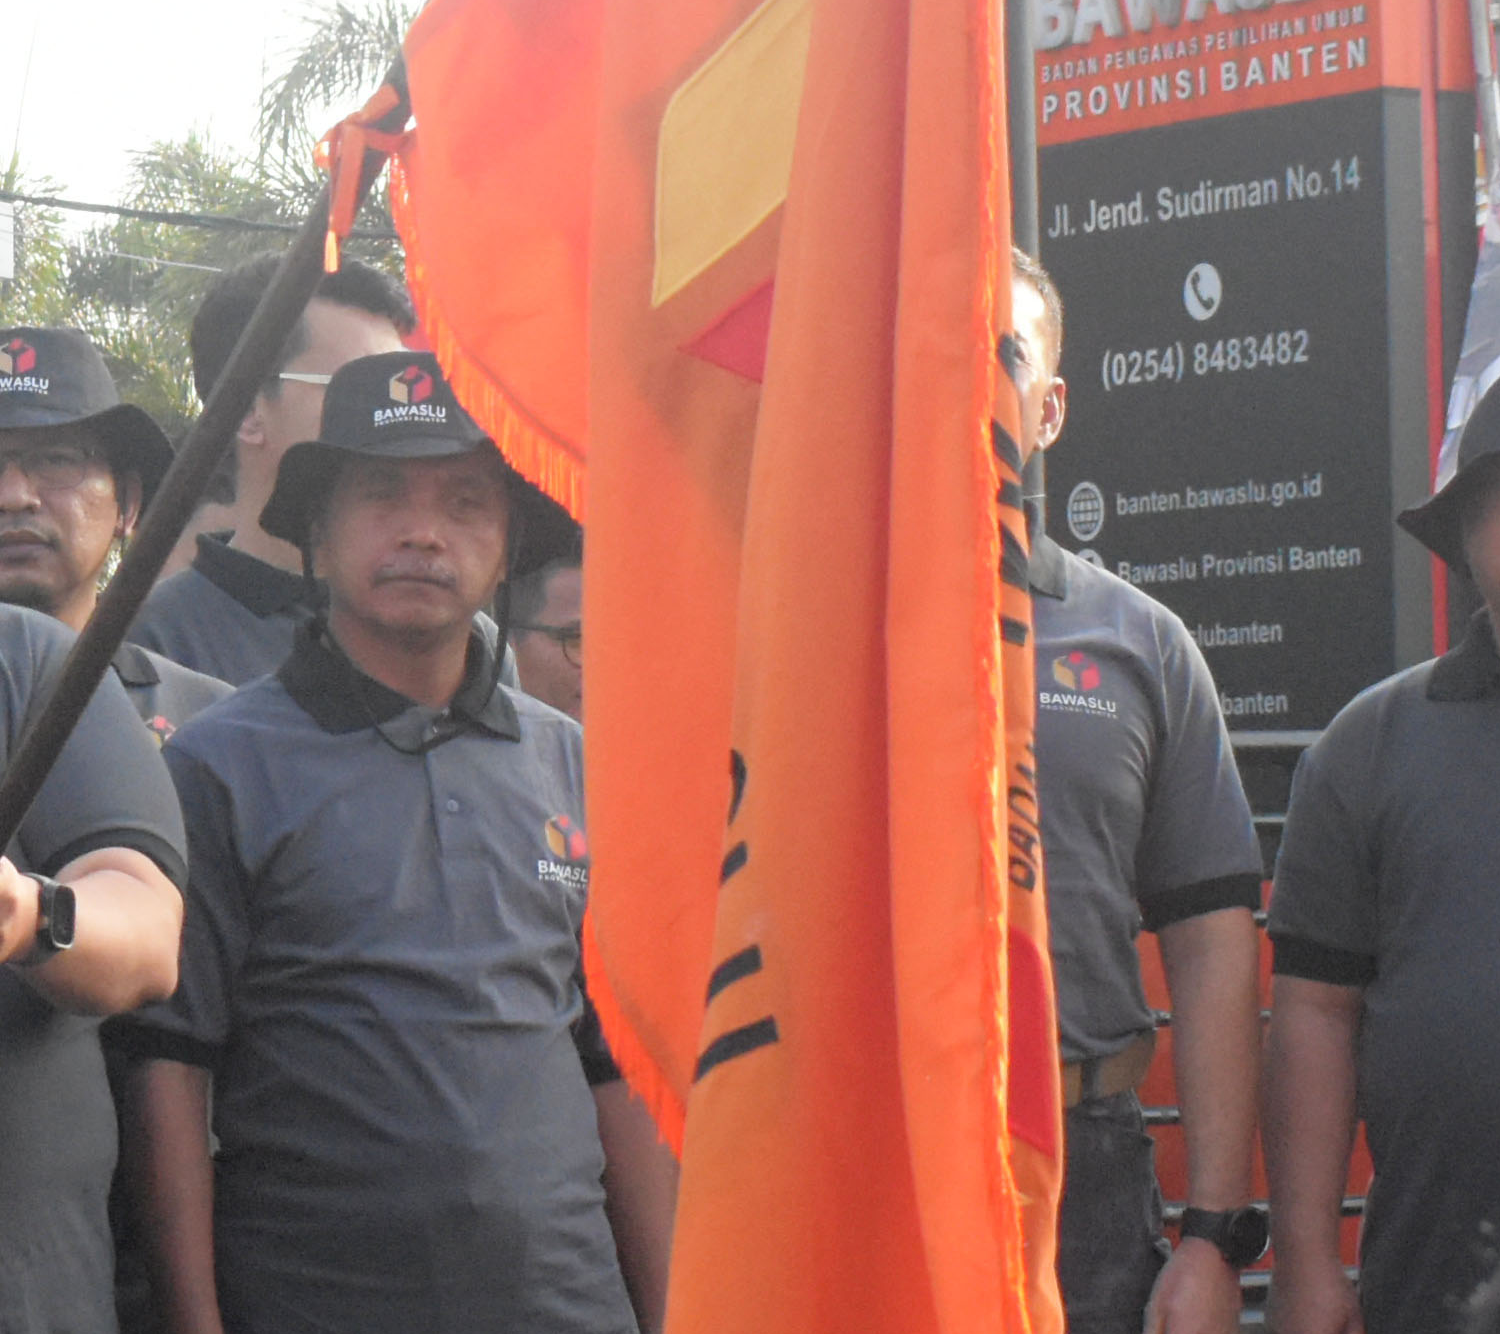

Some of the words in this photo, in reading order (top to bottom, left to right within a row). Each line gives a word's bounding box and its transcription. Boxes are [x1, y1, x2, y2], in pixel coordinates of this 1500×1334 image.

[1042, 57, 1099, 83] BADAN
[1103, 36, 1199, 72] PENGAWAS
[1205, 16, 1306, 52] PEMILIHAN
[1312, 4, 1366, 33] UMUM
[1043, 67, 1207, 124] PROVINSI
[1220, 38, 1367, 92] BANTEN
[1048, 204, 1076, 238] Jl.
[1083, 191, 1149, 234] Jend.
[1157, 177, 1278, 221] Sudirman
[1286, 155, 1361, 201] No.14
[1102, 341, 1184, 391] (0254)
[1193, 329, 1309, 375] 8483482
[374, 404, 446, 422] BAWASLU
[1117, 473, 1322, 515] banten.bawaslu.go.id
[1118, 557, 1197, 585] Bawaslu
[1202, 548, 1283, 578] Provinsi
[1289, 545, 1362, 571] Banten
[1040, 692, 1116, 713] BAWASLU
